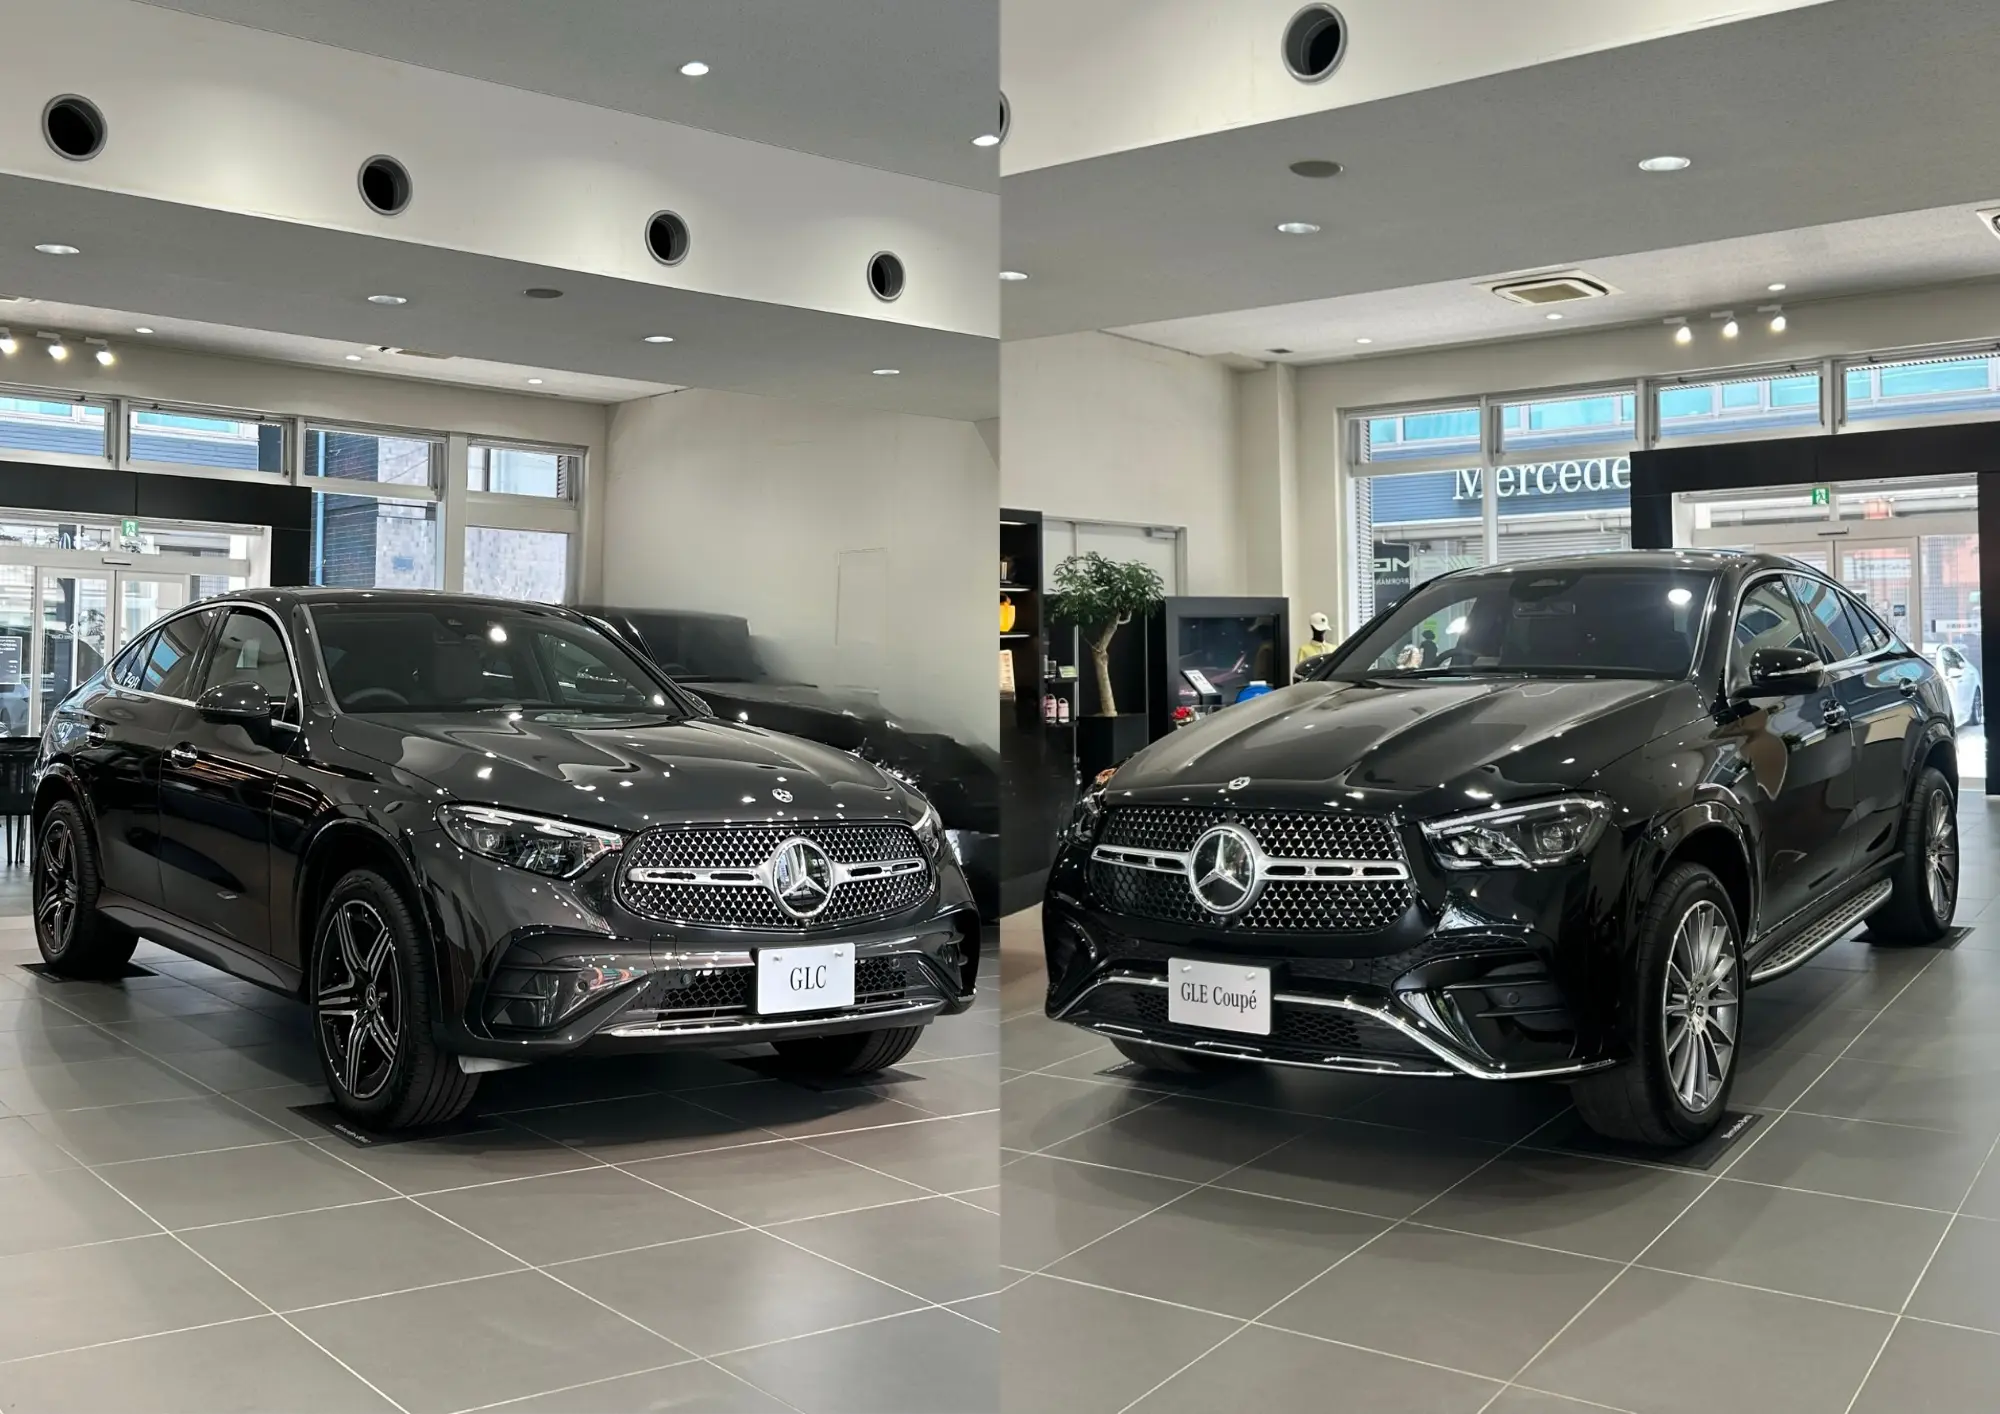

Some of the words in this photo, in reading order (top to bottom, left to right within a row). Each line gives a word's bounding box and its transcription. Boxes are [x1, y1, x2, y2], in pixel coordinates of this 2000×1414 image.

[789, 964, 827, 991] GLC
[1181, 982, 1208, 1004] GLE
[1213, 986, 1257, 1013] Coupé
